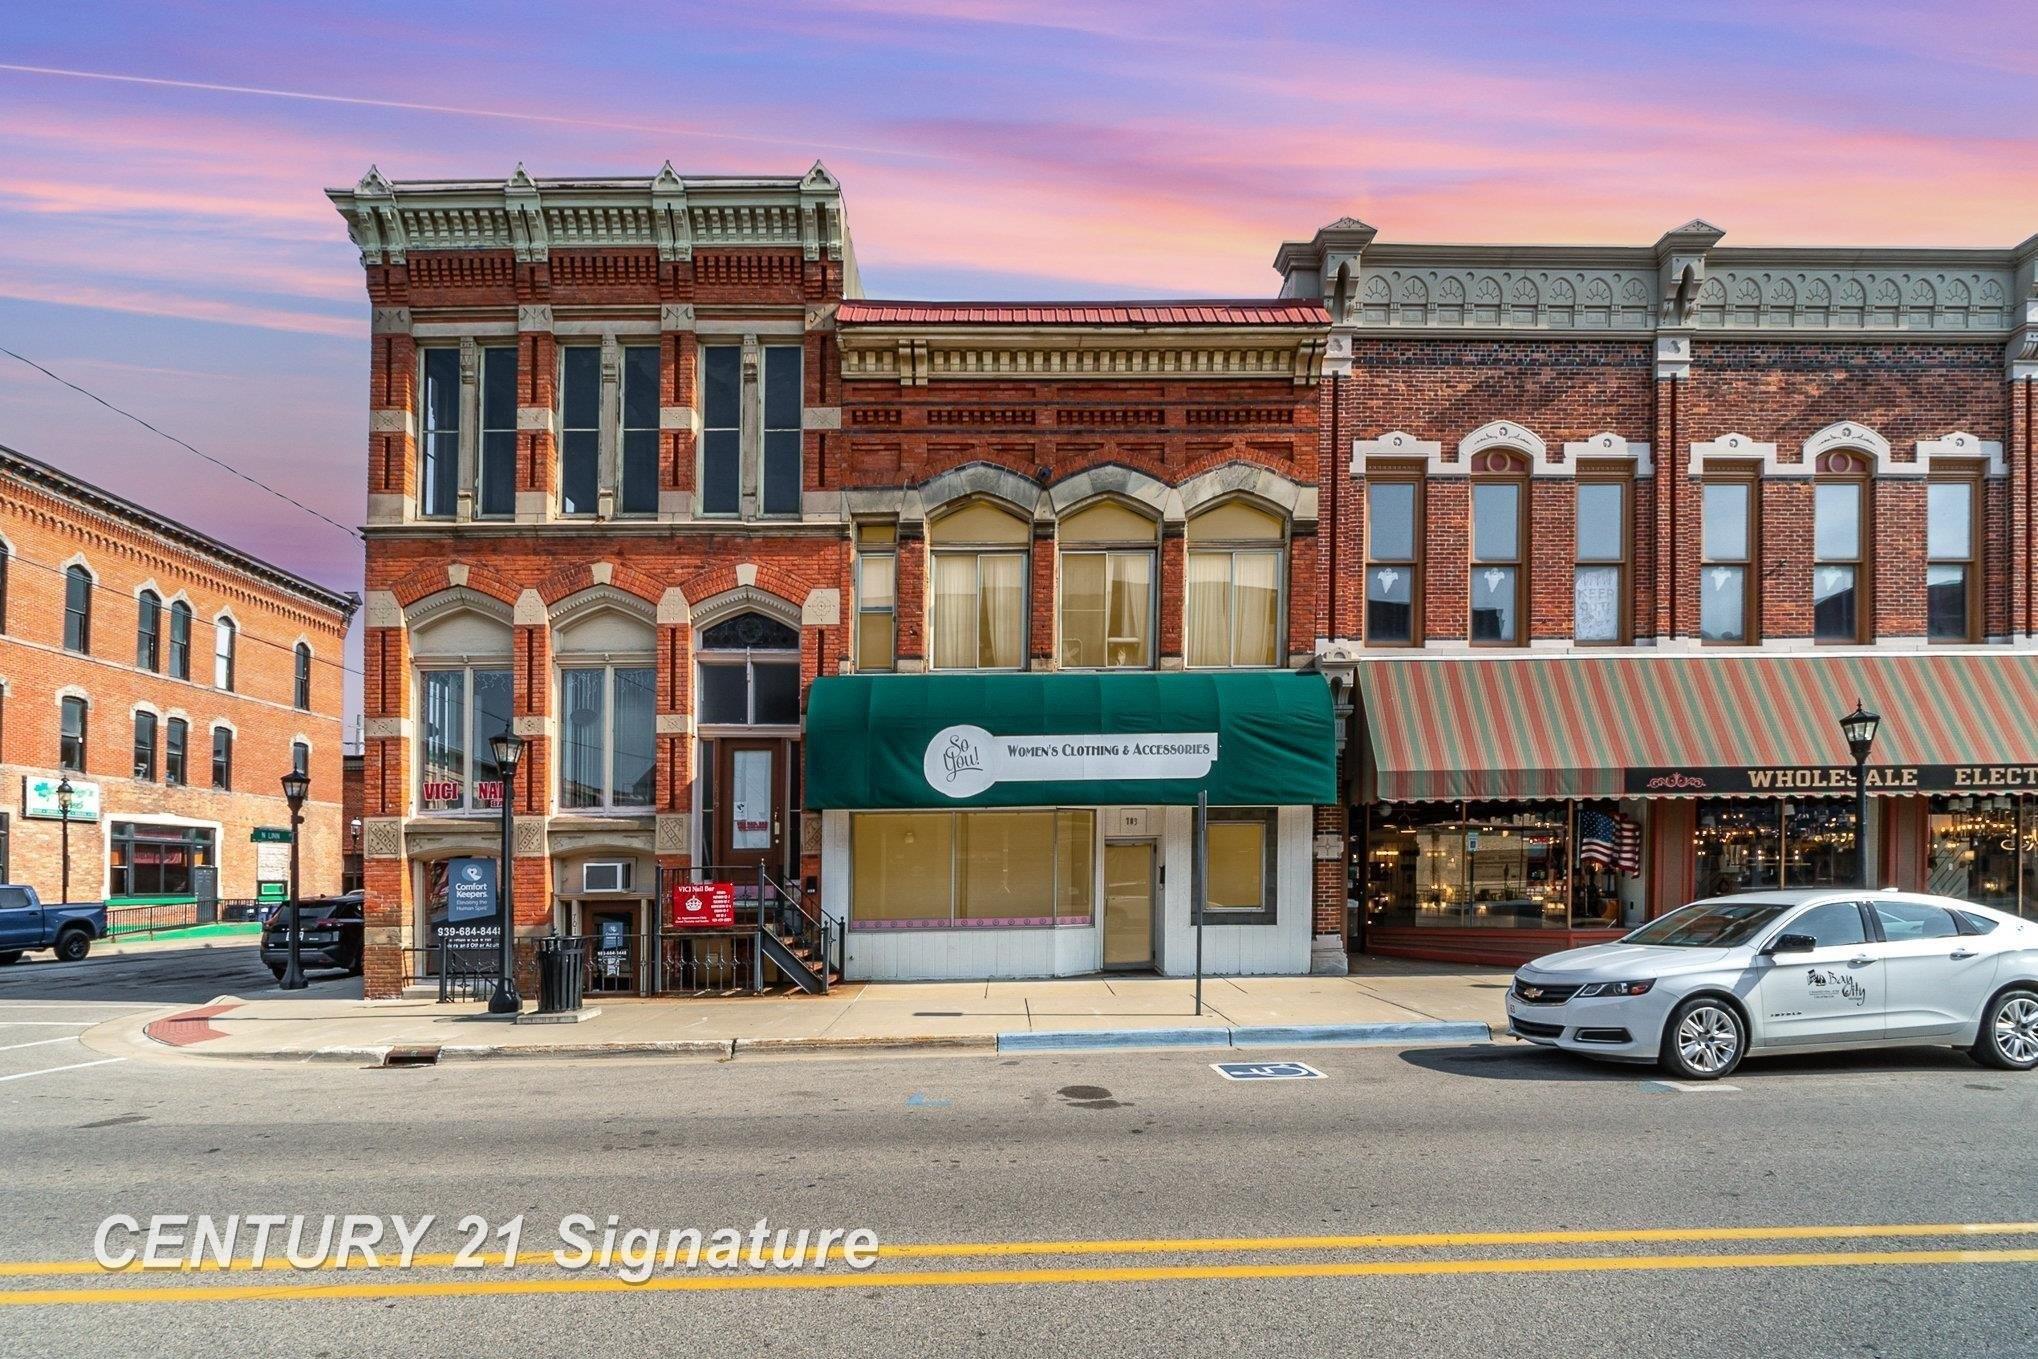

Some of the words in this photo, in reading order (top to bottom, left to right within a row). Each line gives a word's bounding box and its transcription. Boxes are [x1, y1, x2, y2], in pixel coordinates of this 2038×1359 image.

[949, 735, 969, 755] So
[1007, 745, 1058, 757] WOMEN'S
[1062, 744, 1119, 756] CLOTHING
[1122, 748, 1130, 756] &
[1133, 743, 1210, 755] ACCESSORIES
[423, 782, 459, 800] VICI
[477, 781, 503, 800] NAI
[455, 883, 487, 891] Comfort
[456, 891, 487, 899] Keepers
[1828, 970, 1853, 986] Bay
